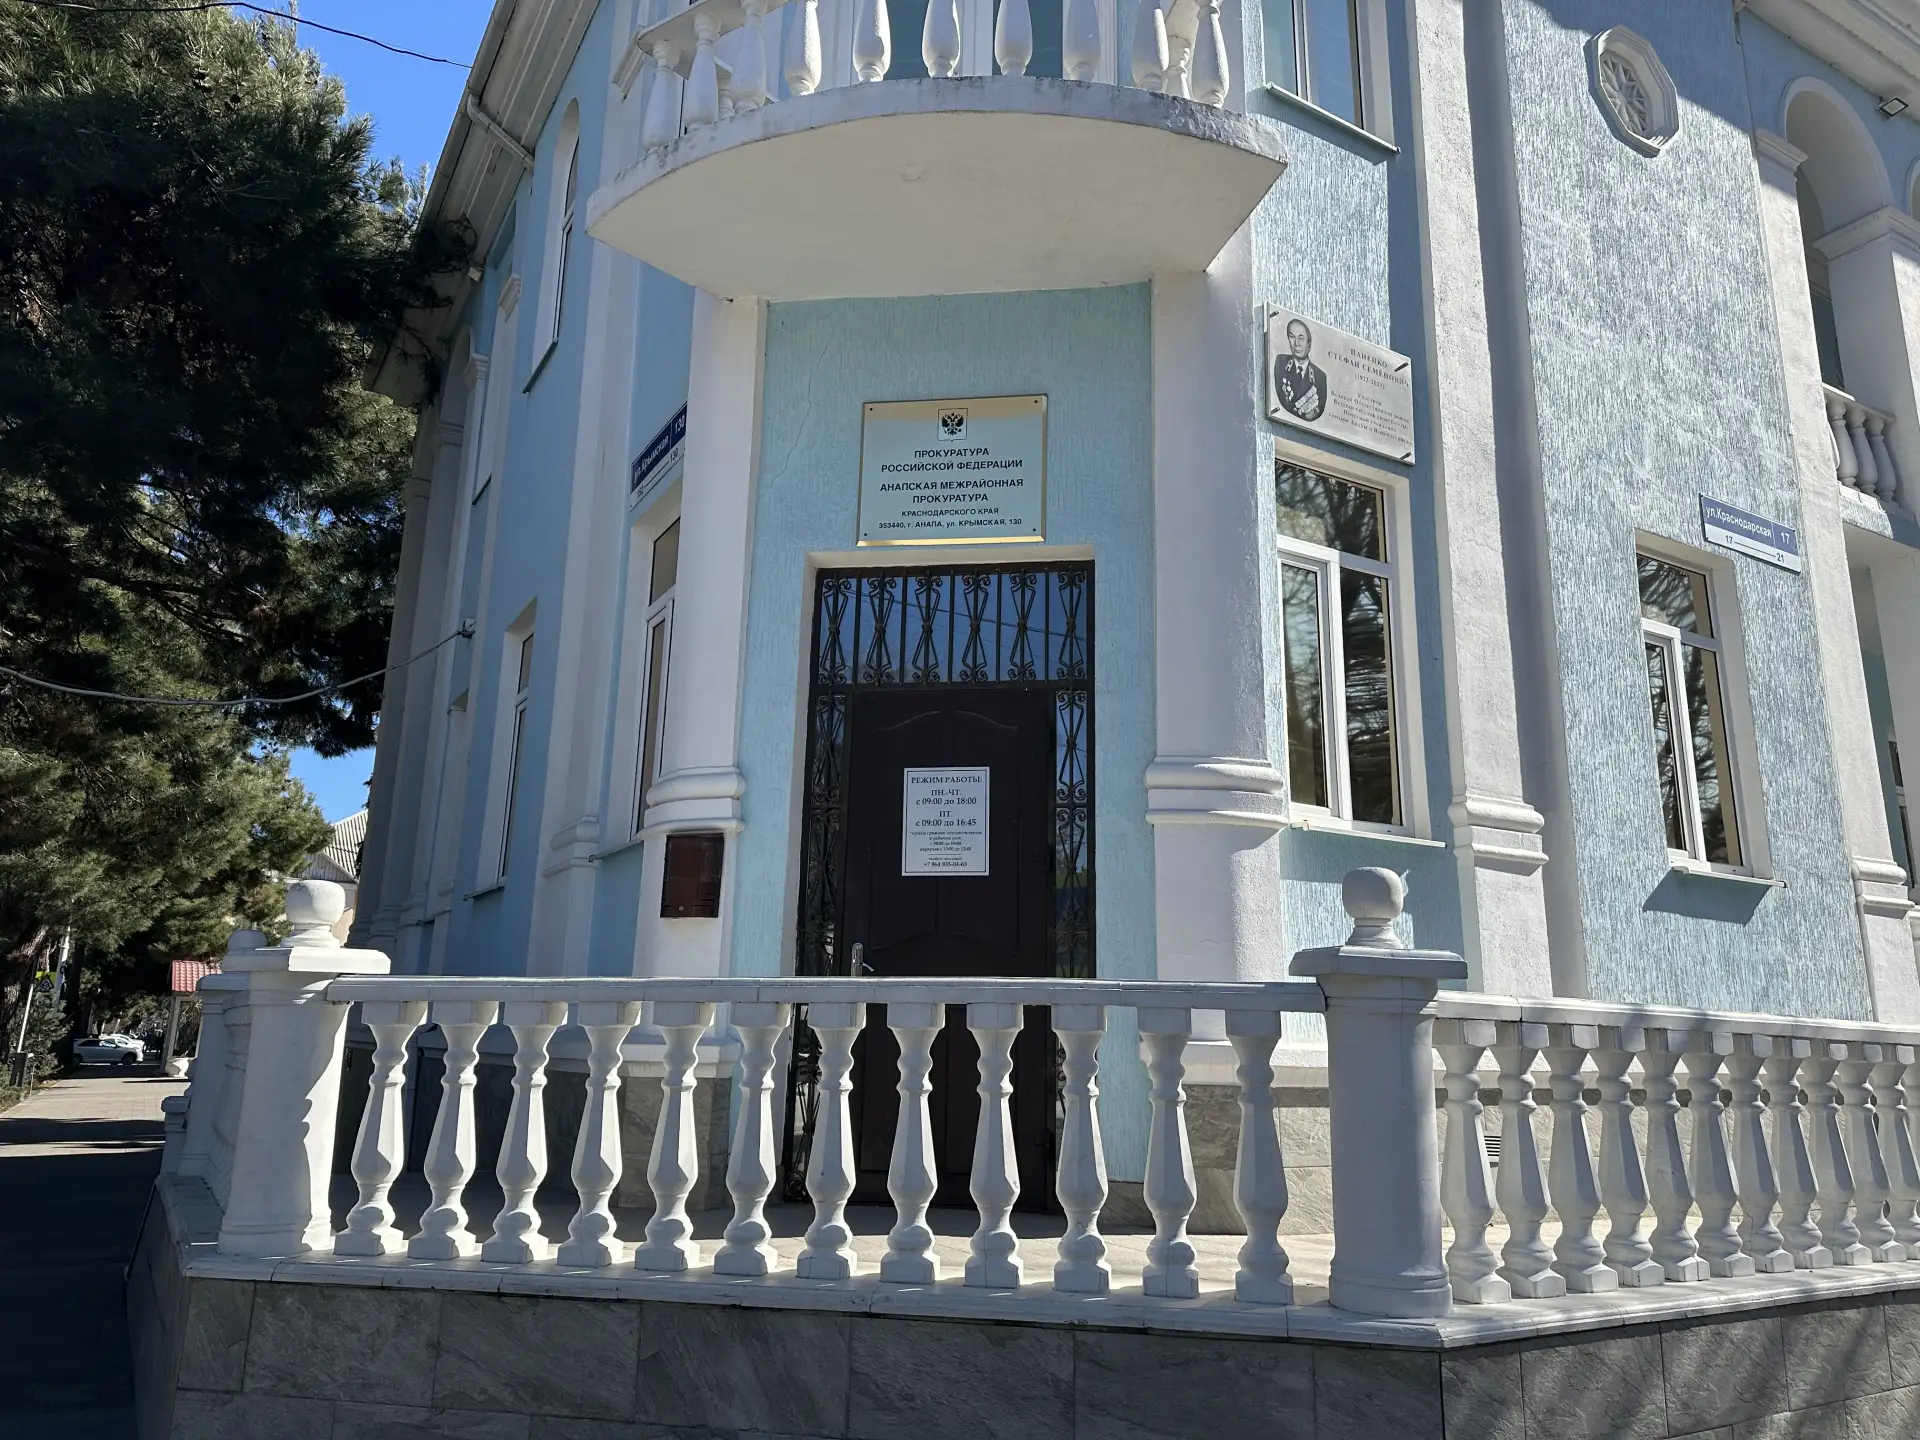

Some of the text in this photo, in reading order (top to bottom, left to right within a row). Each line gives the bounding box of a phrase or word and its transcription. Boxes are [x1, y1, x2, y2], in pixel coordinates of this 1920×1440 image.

[1328, 350, 1359, 368] СТЕФАН
[915, 448, 989, 458] ПРОКУРАТУРА
[881, 460, 1022, 472] РОССИЙСКОЙ ФЕДЕРАЦИИ
[880, 478, 1023, 491] АНАПСКАЯ МЕЖРАЙОННАЯ
[913, 494, 988, 503] ПРОКУРАТУРА
[902, 509, 976, 517] КРАСНОДАРСКОГО
[959, 519, 1006, 527] КРЫМСКАЯ,
[1781, 532, 1789, 544] 17
[1726, 535, 1784, 562] 17 21
